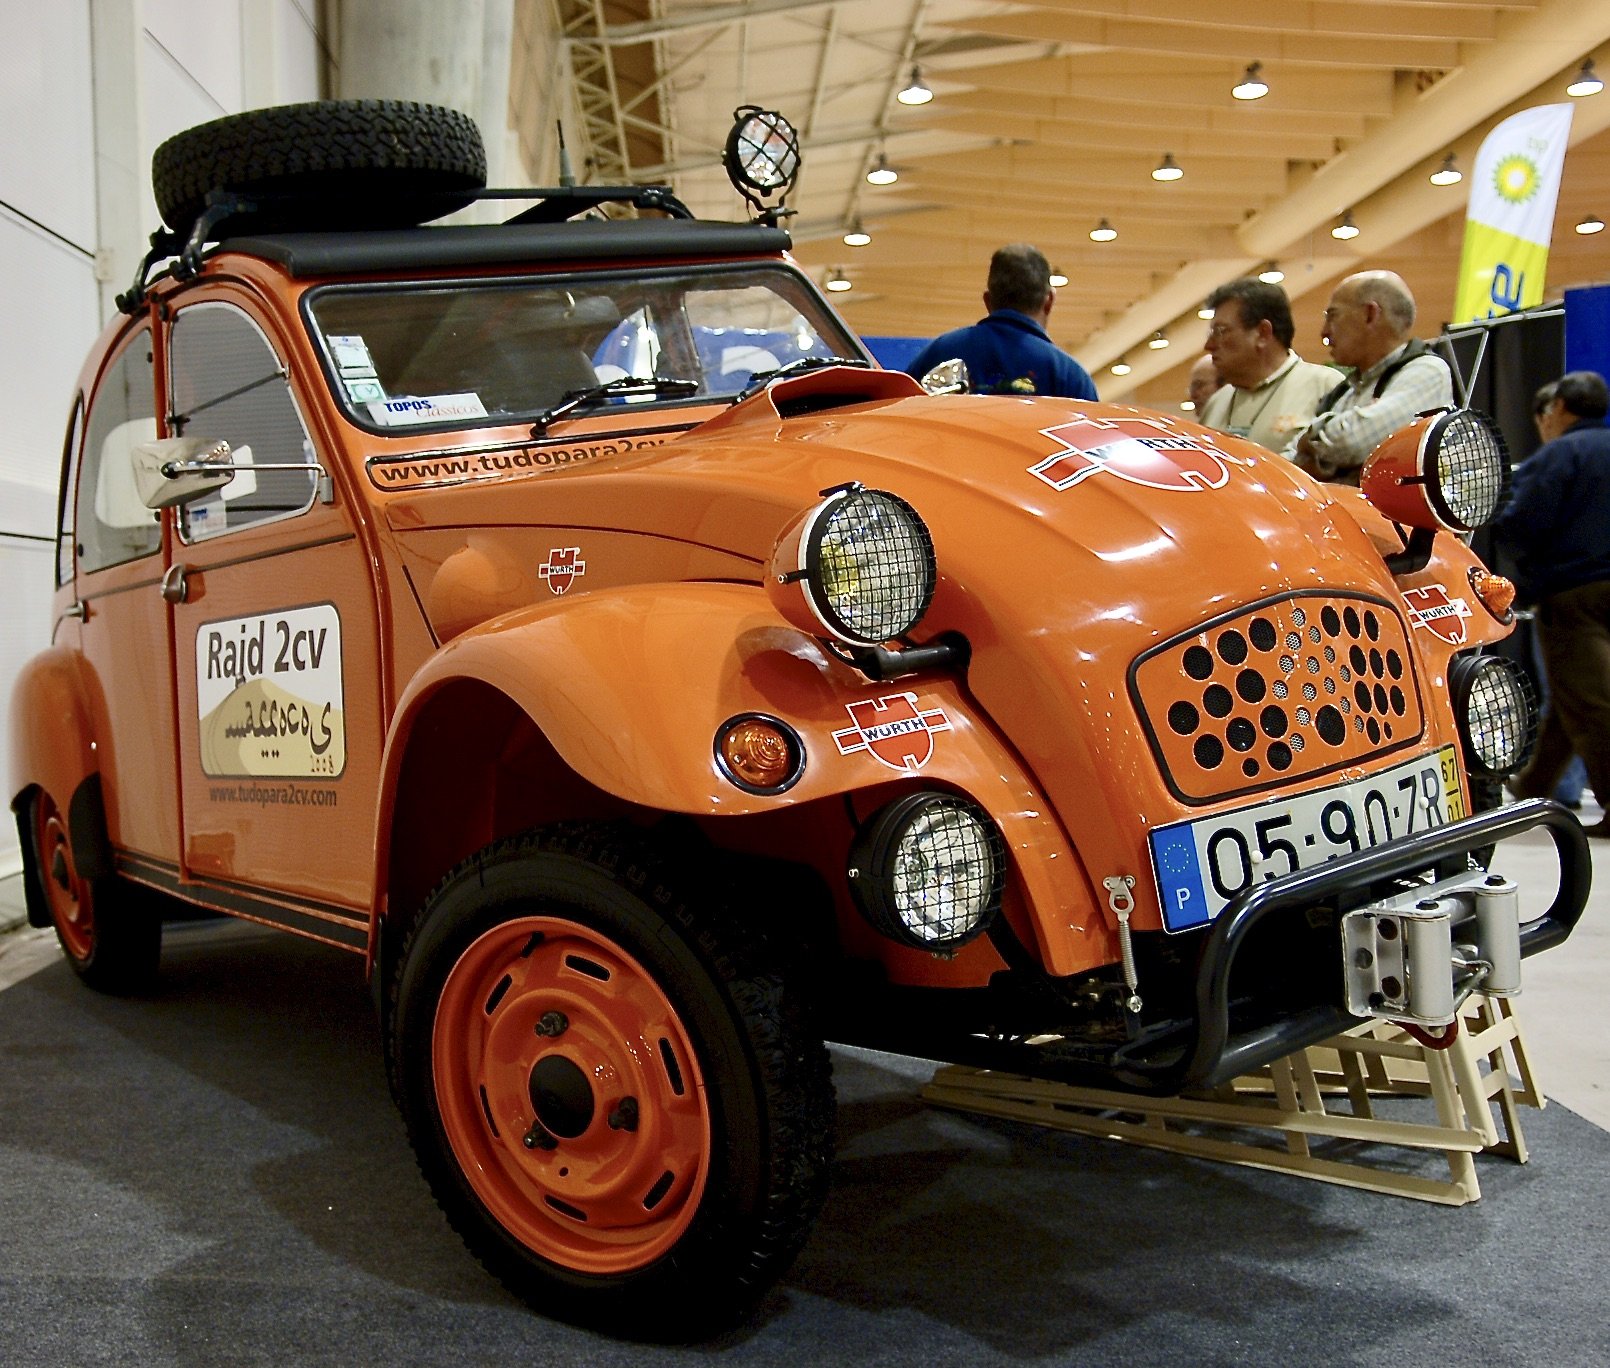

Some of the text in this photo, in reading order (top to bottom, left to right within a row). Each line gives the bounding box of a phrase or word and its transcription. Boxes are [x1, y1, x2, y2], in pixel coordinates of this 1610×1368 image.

[384, 400, 433, 413] TOPOS
[207, 620, 265, 679] Raid
[1440, 757, 1457, 784] 67
[209, 782, 337, 808] www.tudopara2cv.com
[1175, 887, 1191, 910] P
